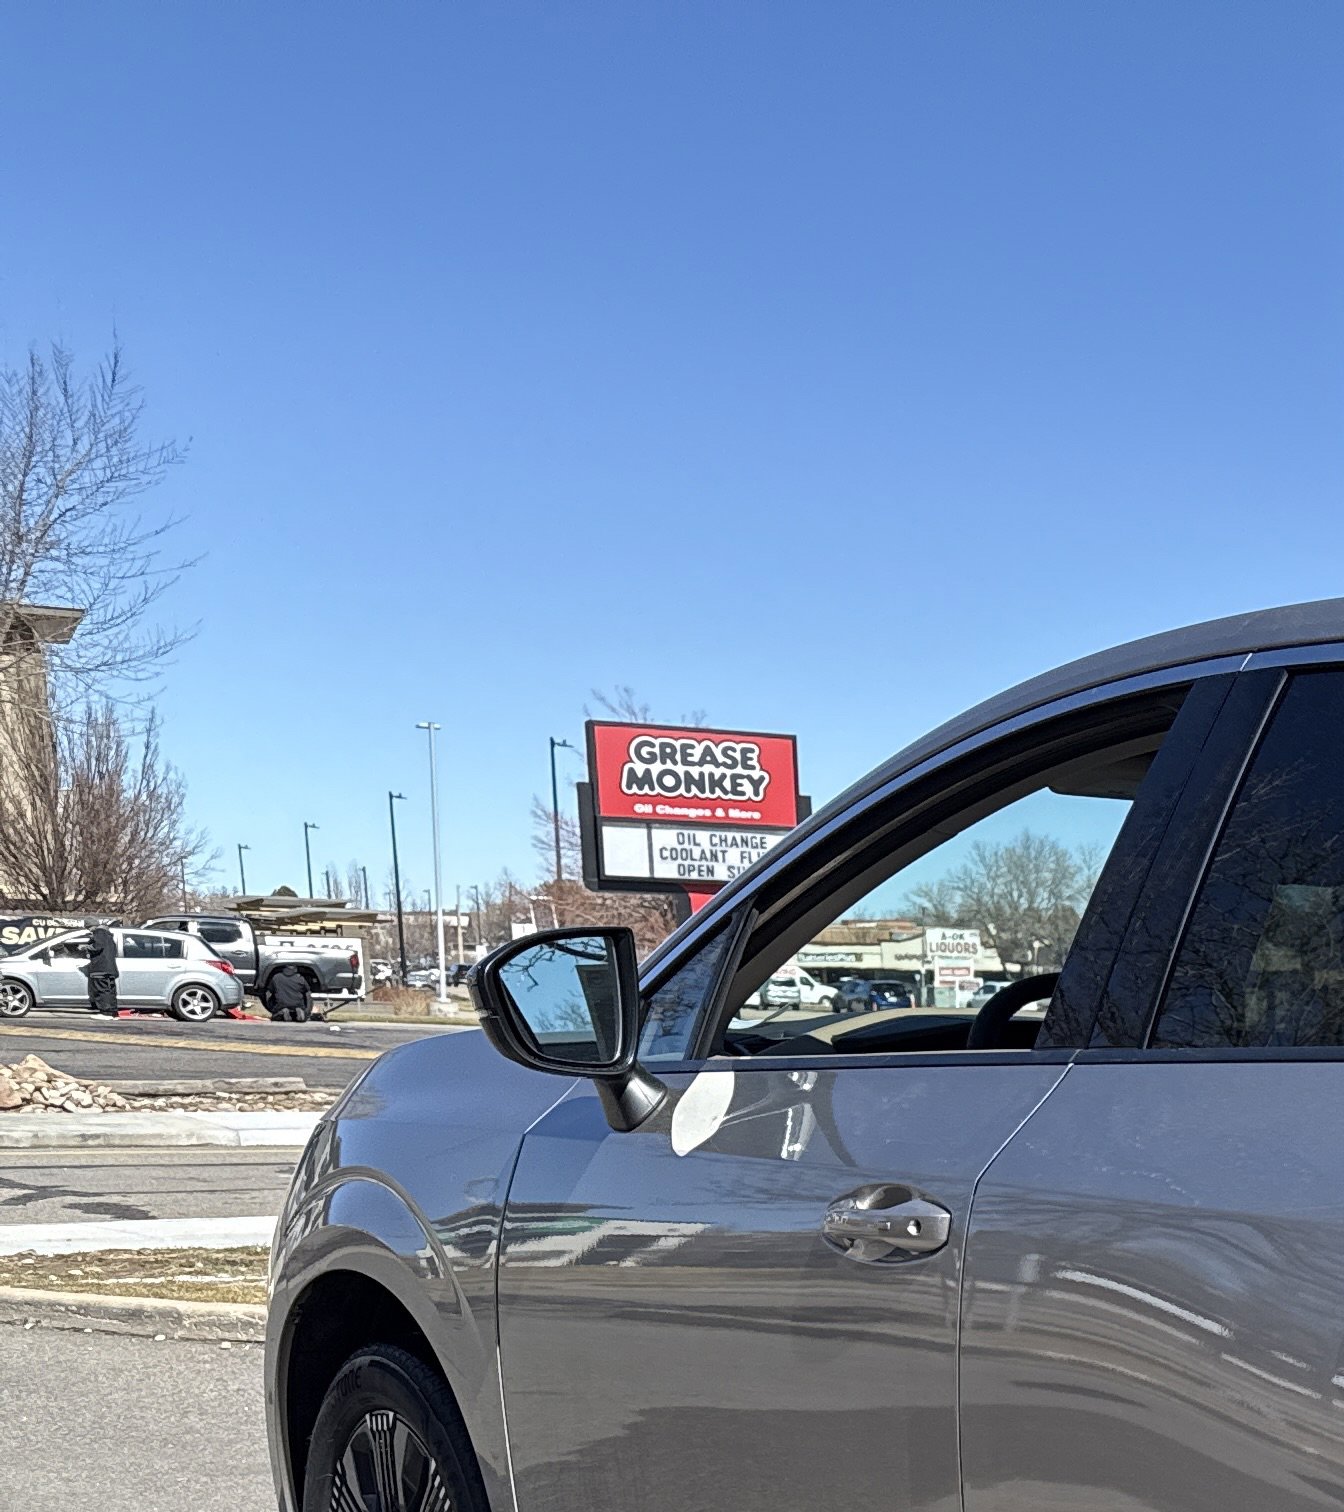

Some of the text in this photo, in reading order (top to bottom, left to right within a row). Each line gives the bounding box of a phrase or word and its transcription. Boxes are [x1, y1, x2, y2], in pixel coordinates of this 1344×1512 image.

[633, 740, 757, 770] GREASE
[625, 766, 766, 797] MONKEY
[633, 803, 653, 814] Oil
[656, 804, 712, 819] Changes
[728, 808, 761, 819] More
[676, 832, 768, 850] OIL CHANGE
[659, 847, 728, 864] COOLANT
[677, 864, 715, 878] OPEN
[2, 926, 66, 945] SAV
[929, 942, 978, 955] LIQUORS
